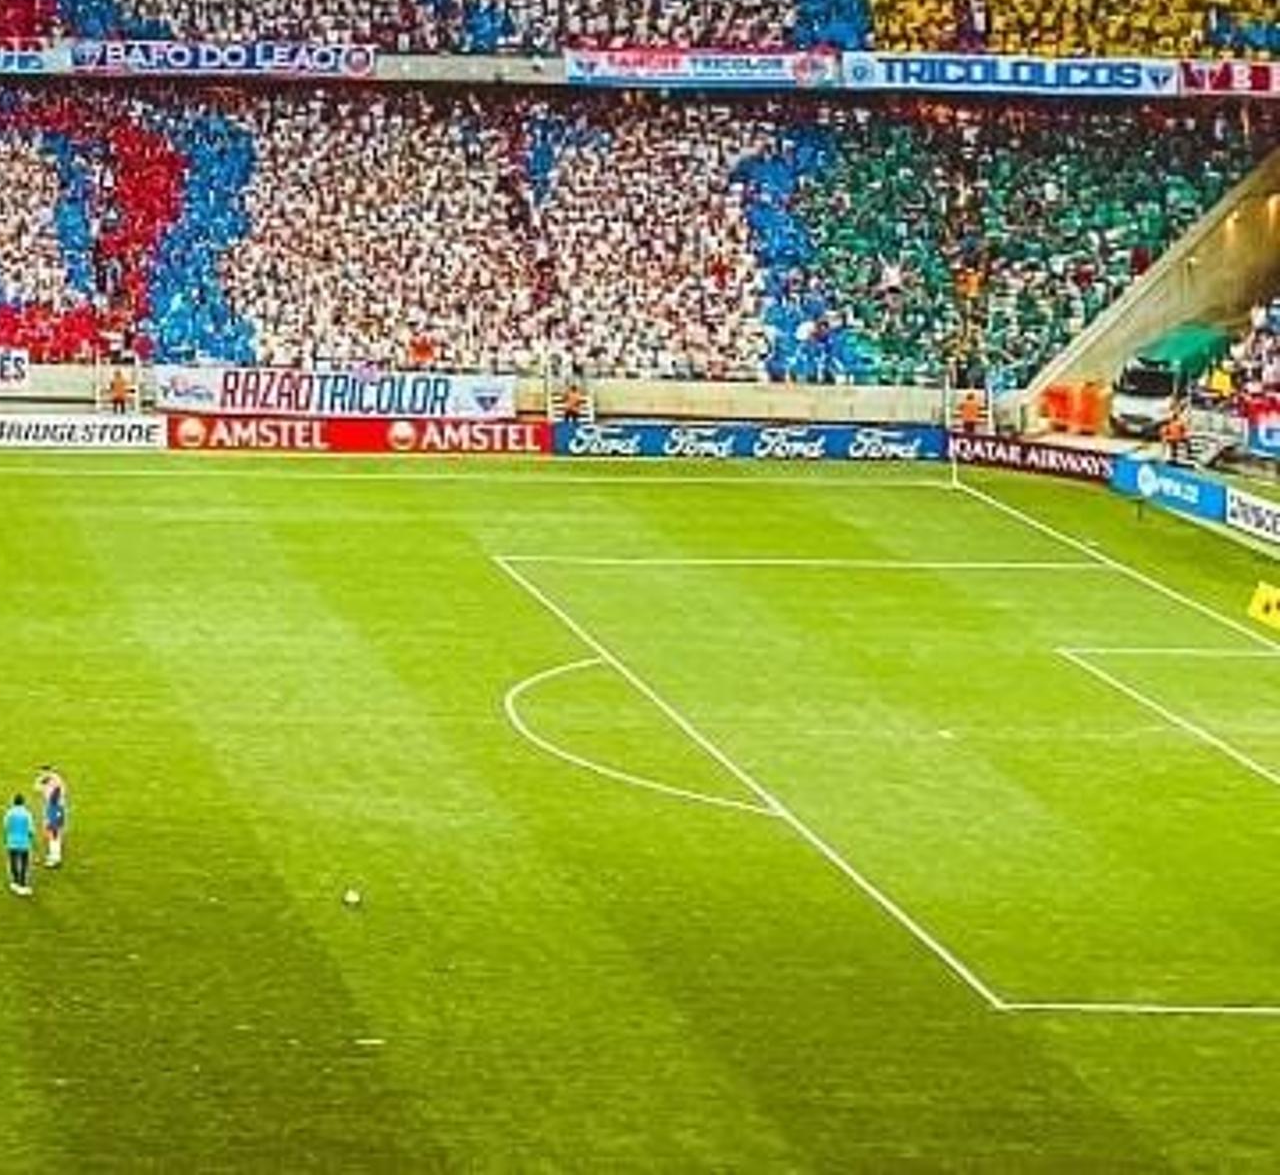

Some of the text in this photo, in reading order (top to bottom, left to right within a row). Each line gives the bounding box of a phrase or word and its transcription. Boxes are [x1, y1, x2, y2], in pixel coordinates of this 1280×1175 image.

[198, 43, 247, 68] DO
[210, 421, 330, 449] AMSTEL
[422, 422, 541, 451] AMSTEL
[568, 425, 641, 456] Ford
[662, 426, 737, 457] Ford
[753, 426, 827, 458] Ford
[848, 426, 923, 458] Ford
[956, 437, 1021, 465] QATAR
